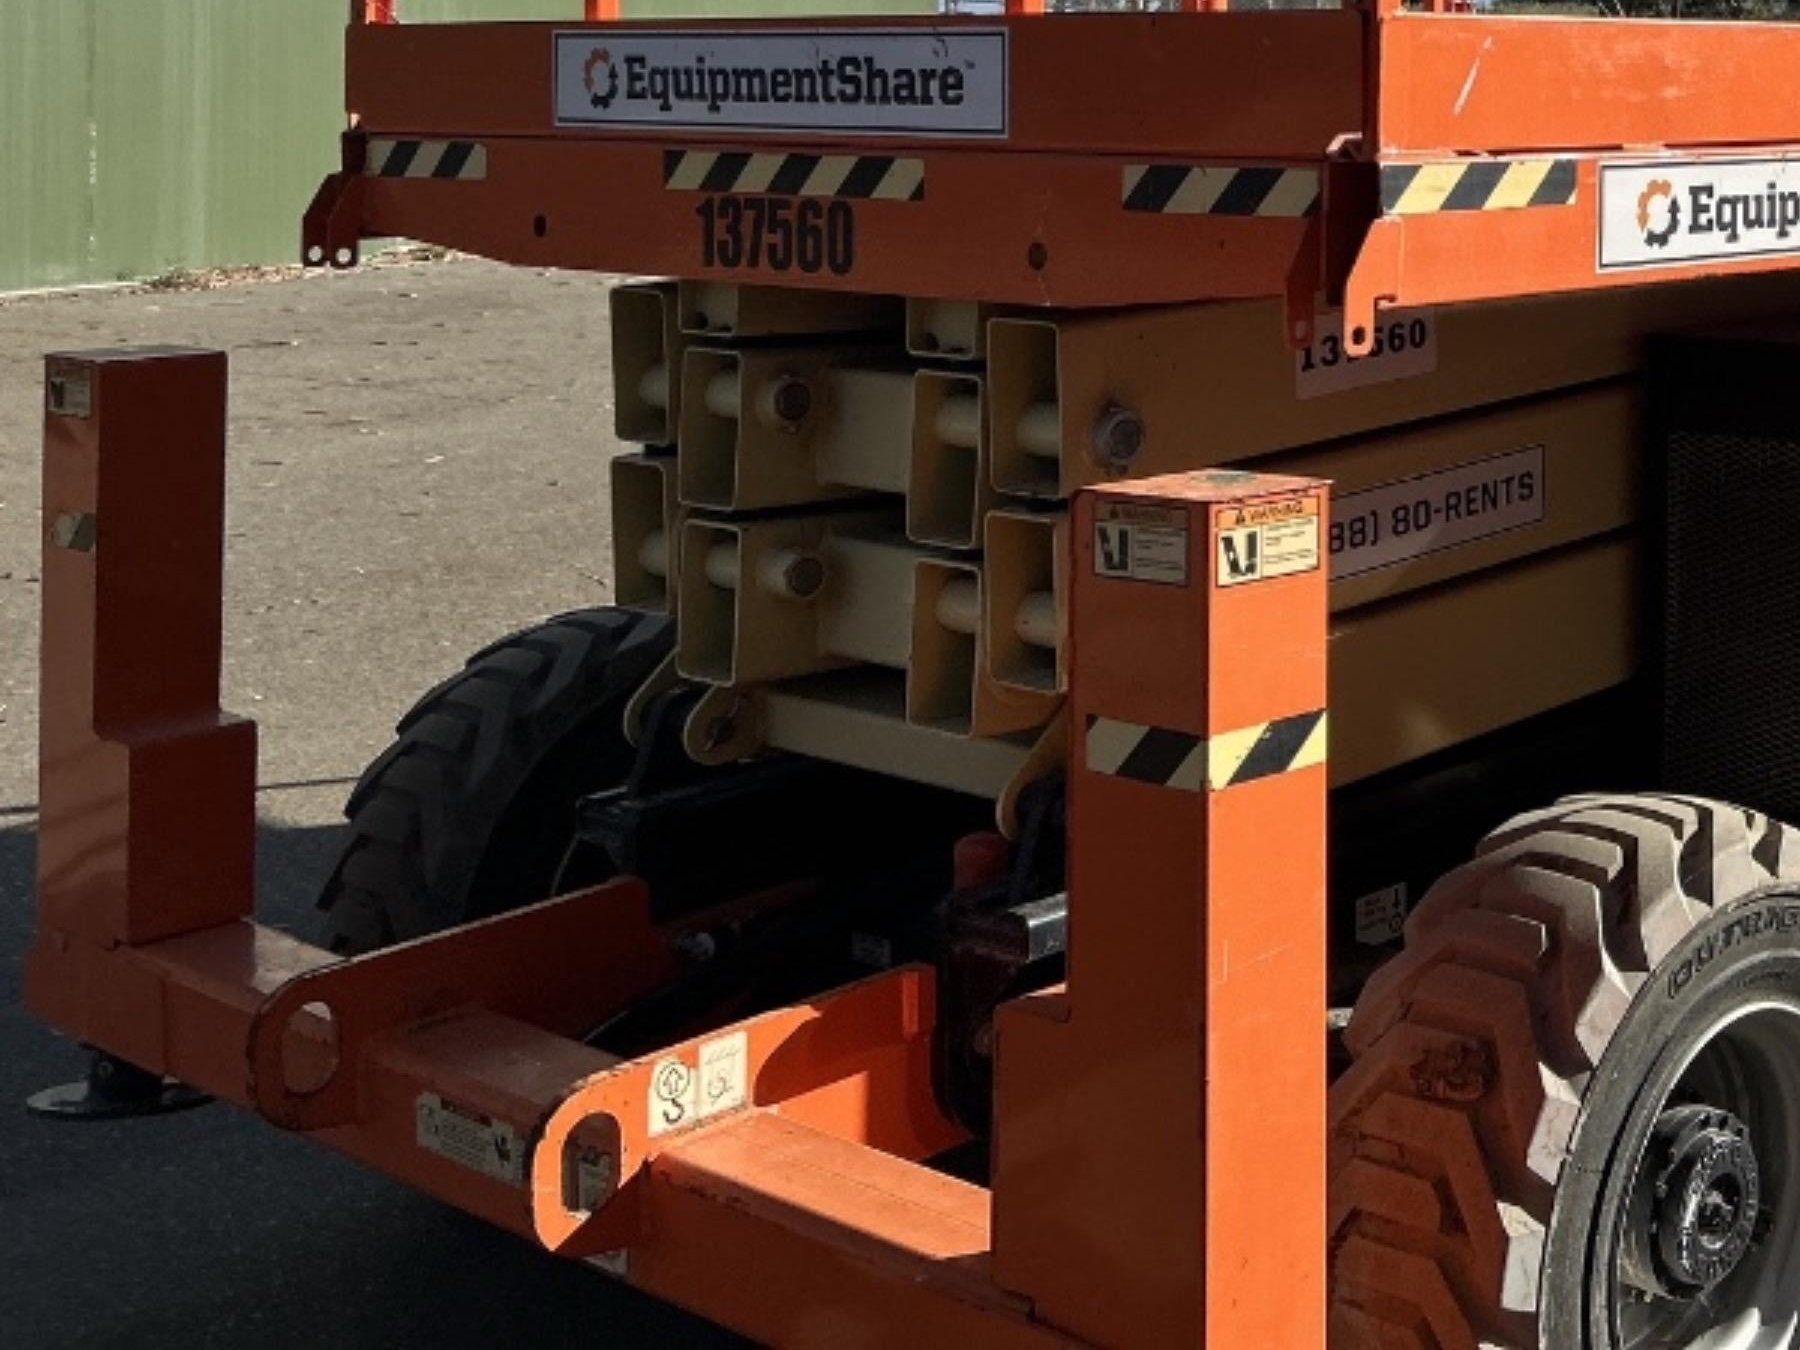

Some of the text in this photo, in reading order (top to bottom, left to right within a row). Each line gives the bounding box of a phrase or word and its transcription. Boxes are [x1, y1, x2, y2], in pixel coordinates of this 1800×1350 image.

[623, 53, 965, 113] EquipmentShare
[695, 195, 855, 276] 137560
[1300, 317, 1427, 373] 13560
[1249, 500, 1304, 523] WARNING
[1329, 509, 1379, 554] 88)
[1390, 469, 1535, 536] 80-RENTS
